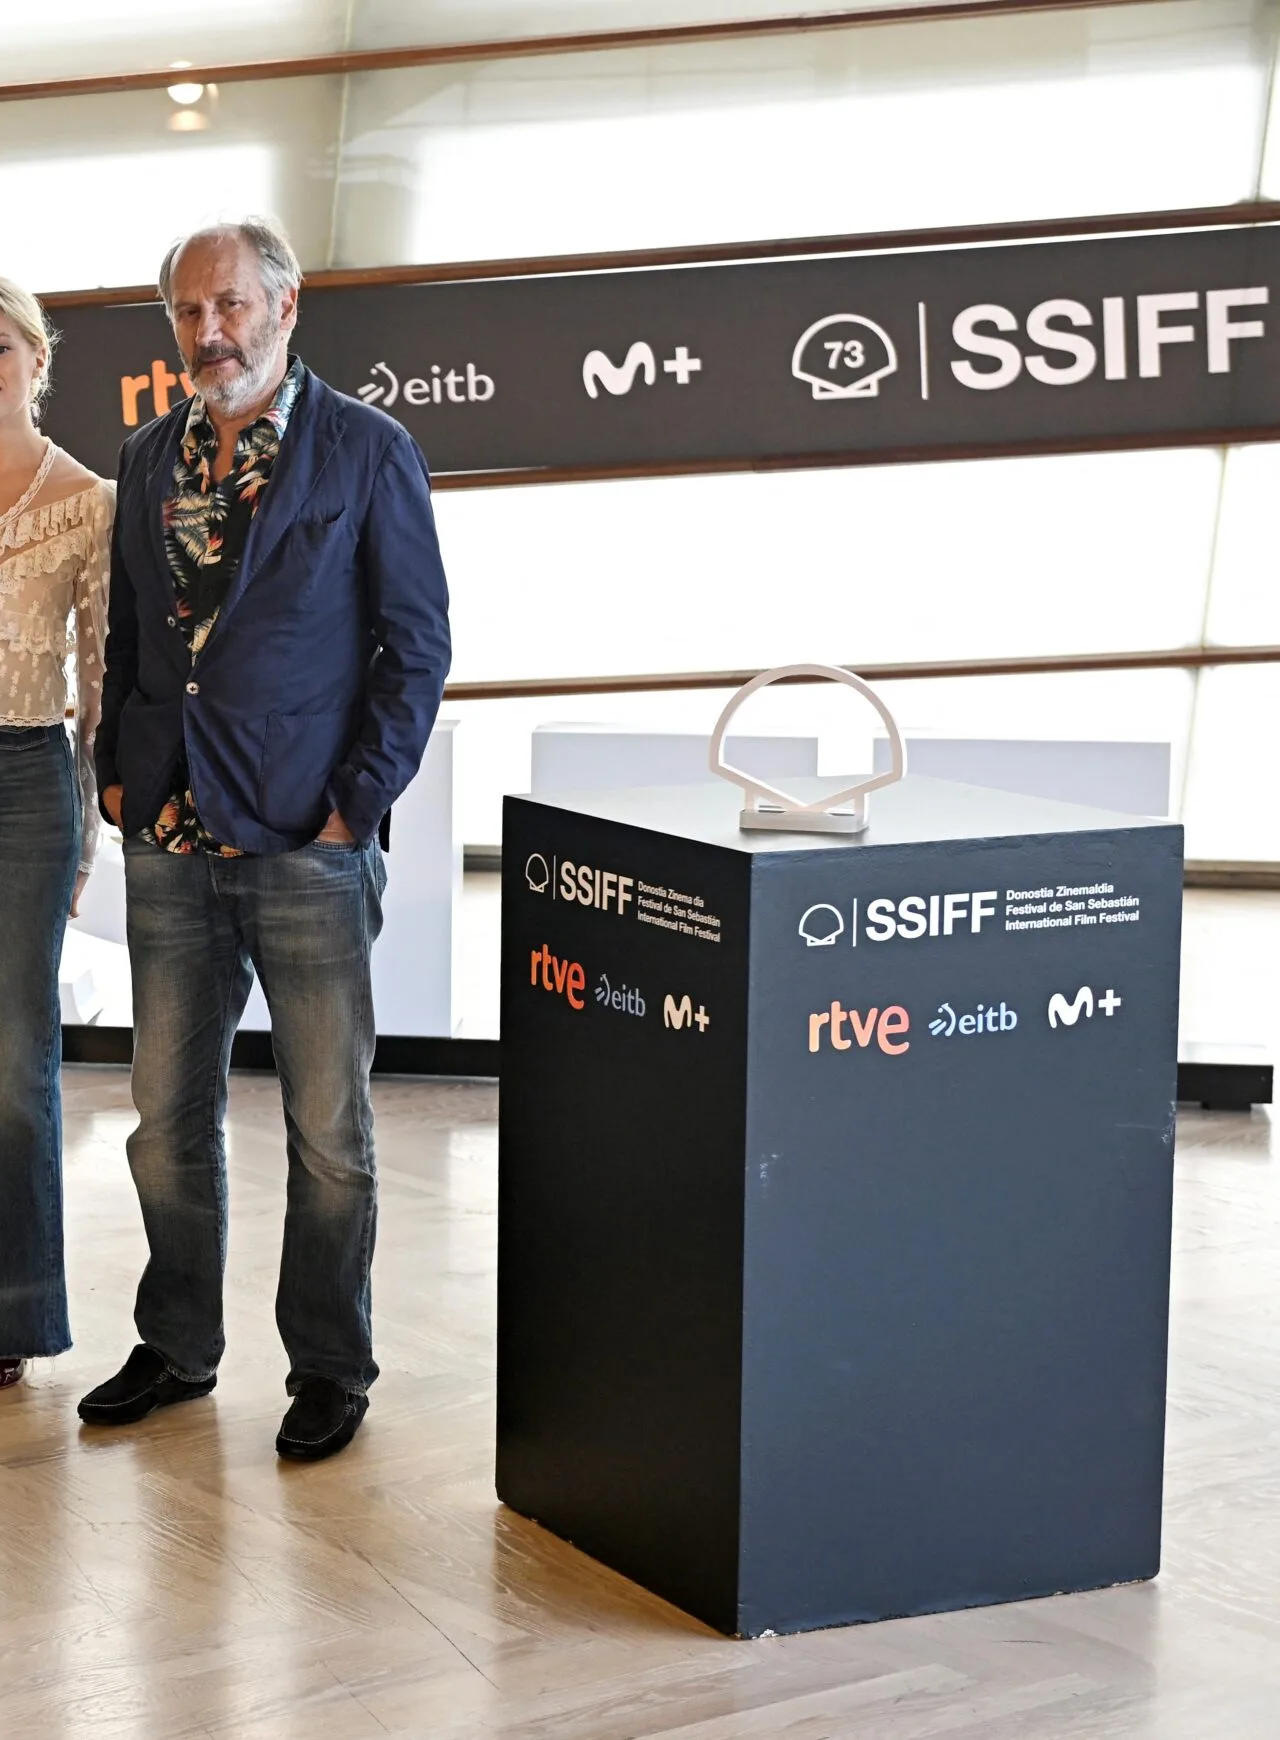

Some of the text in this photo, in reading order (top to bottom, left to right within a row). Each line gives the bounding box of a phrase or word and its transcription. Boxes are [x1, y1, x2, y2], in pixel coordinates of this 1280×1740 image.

[824, 340, 866, 370] 73
[950, 287, 1270, 390] SSIFF
[403, 363, 496, 405] eitb
[582, 341, 702, 399] M+
[121, 360, 197, 426] rt
[560, 861, 633, 915] SSIFF
[638, 881, 667, 898] Donostia
[1006, 883, 1114, 901] Donostia Zinemaldia
[1006, 895, 1140, 916] Festival de San Sebastián
[637, 910, 721, 943] International Film Festival
[638, 896, 721, 928] Festival de San Sebastián
[865, 891, 998, 942] SSIFF
[1005, 910, 1140, 931] International Film Festival
[530, 944, 585, 1010] rtve
[612, 984, 646, 1017] eitb
[664, 994, 710, 1032] M+
[959, 1002, 1018, 1036] eitb
[1048, 986, 1122, 1029] M+
[808, 1001, 910, 1055] rtve
